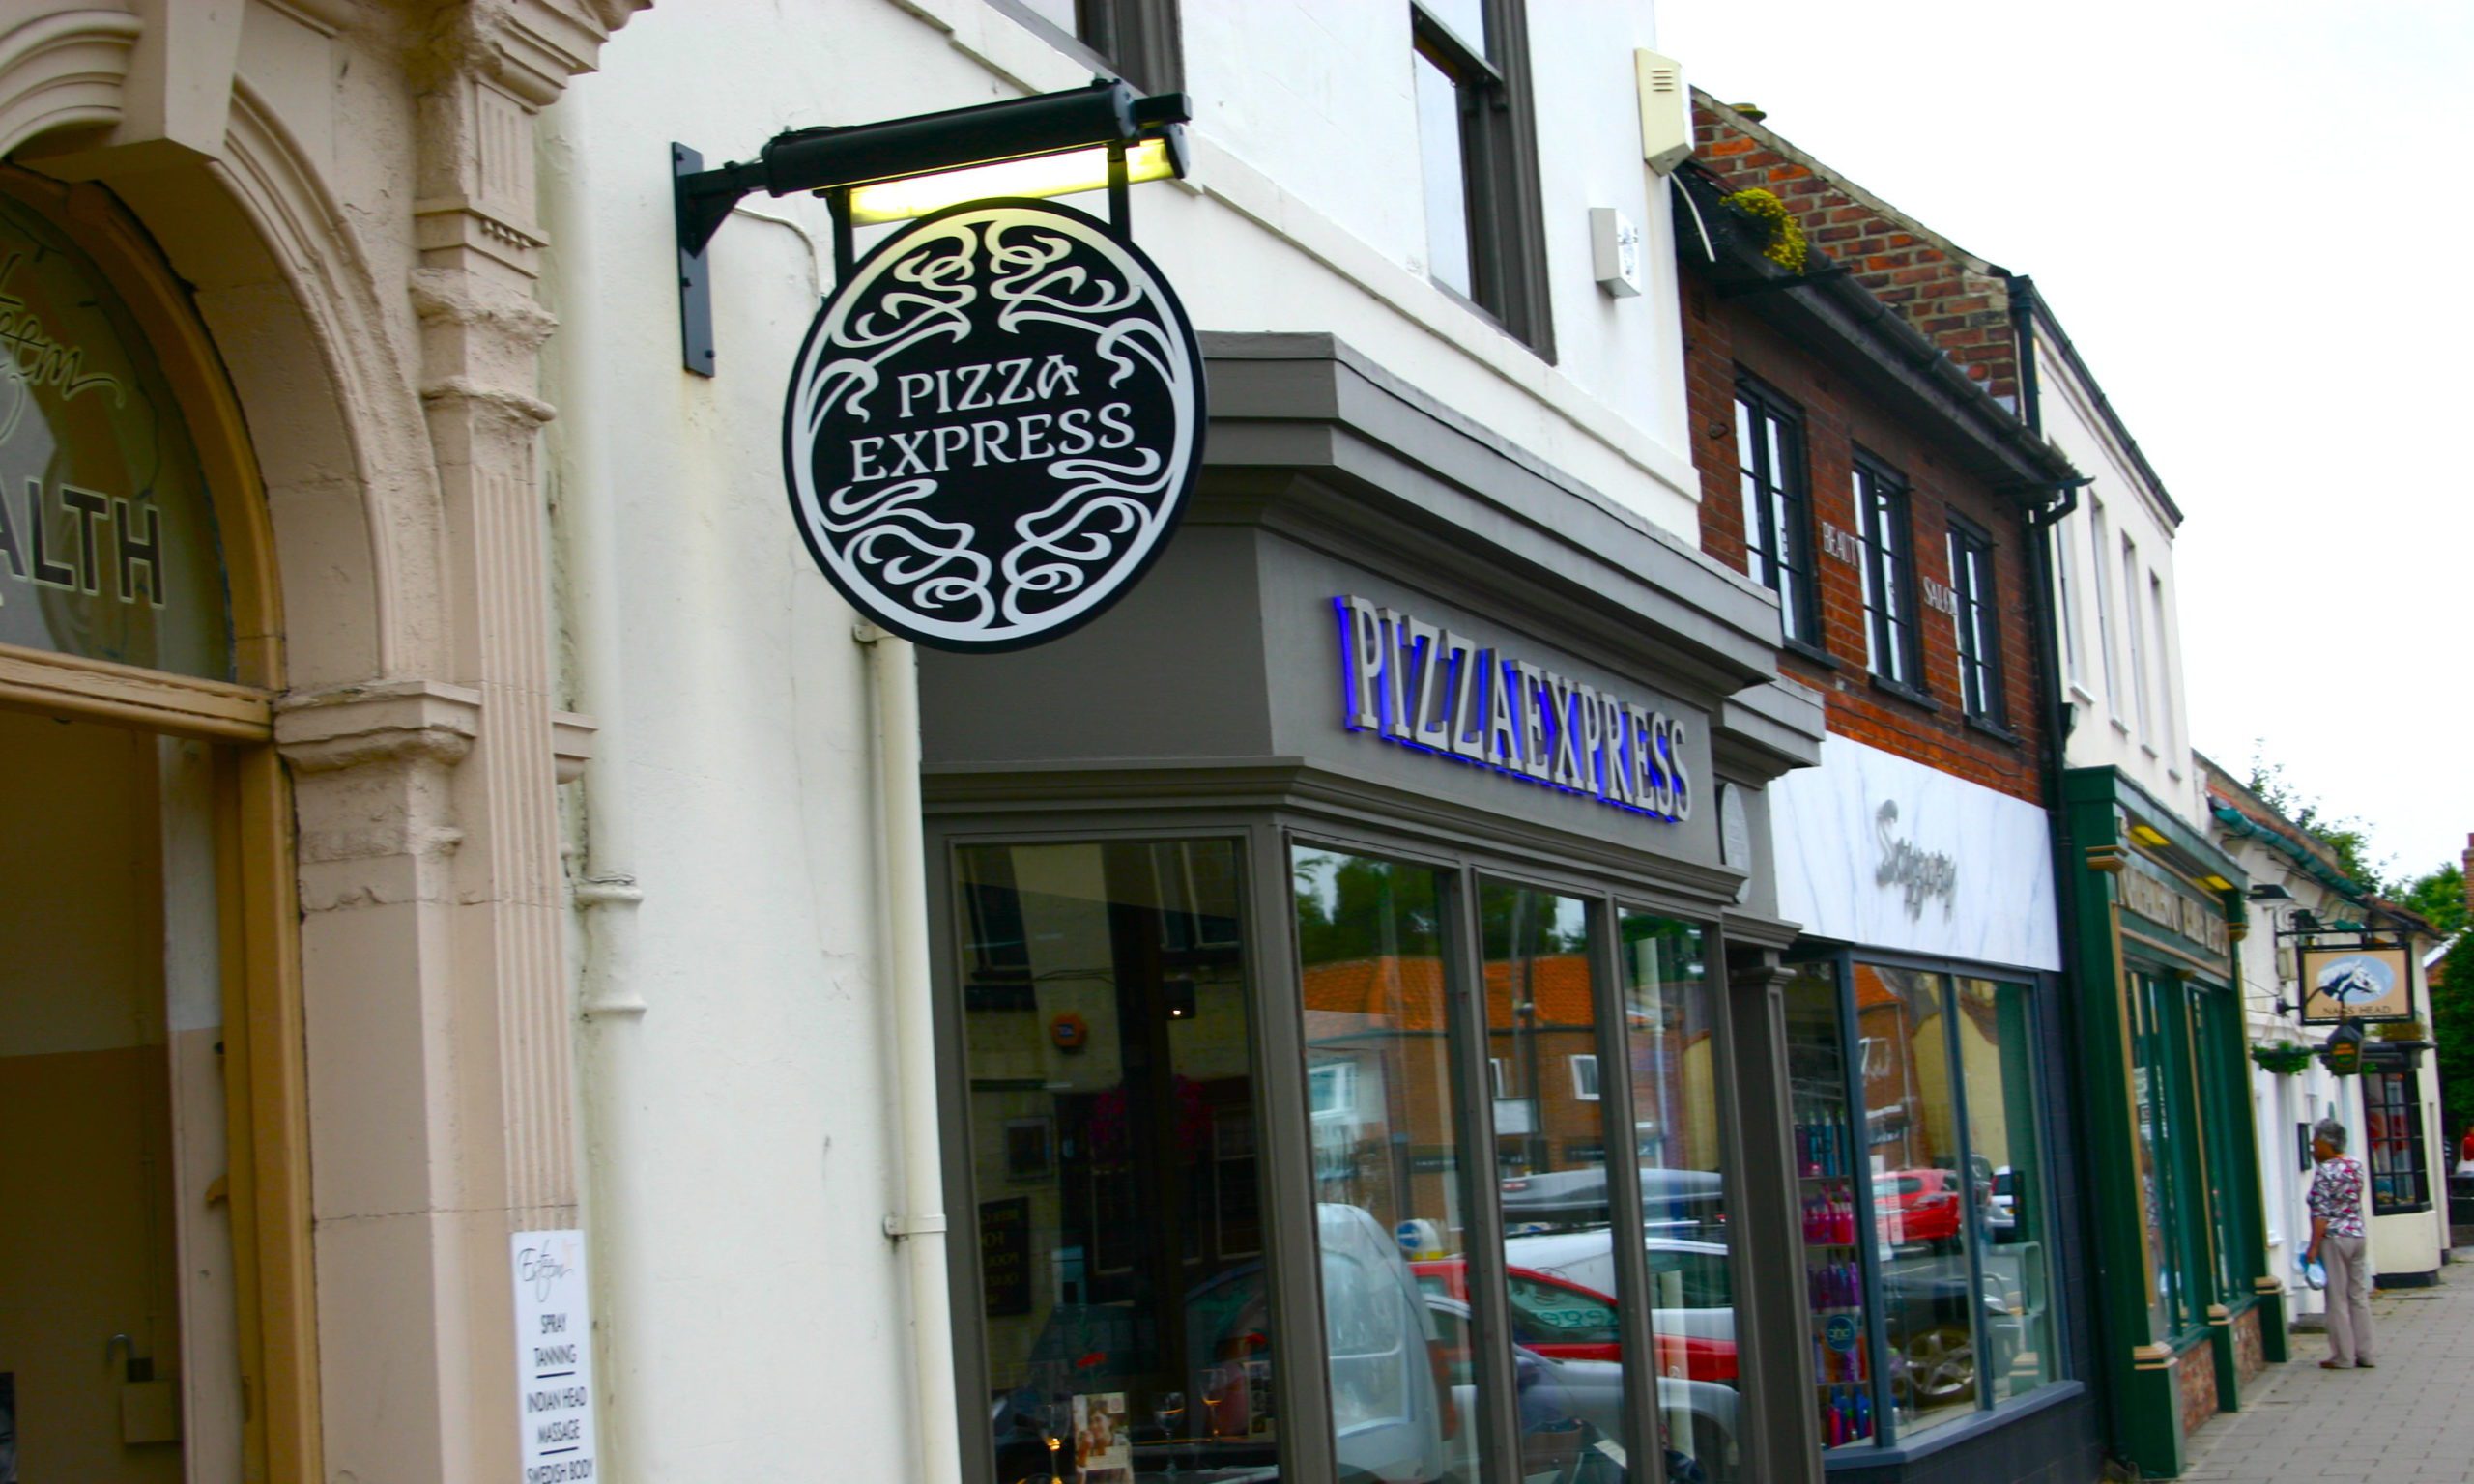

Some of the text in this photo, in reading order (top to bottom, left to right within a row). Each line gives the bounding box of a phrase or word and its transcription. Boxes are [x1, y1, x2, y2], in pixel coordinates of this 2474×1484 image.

[897, 353, 1081, 419] PIZZA
[849, 401, 1136, 483] EXPRESS
[2359, 1005, 2391, 1014] HEAD
[541, 1313, 567, 1334] SPRAY
[534, 1344, 577, 1367] TANNING
[527, 1386, 588, 1413] INDIAN HEAD
[537, 1418, 580, 1444] MASSAGE
[527, 1457, 593, 1484] SWEDISH BODY
